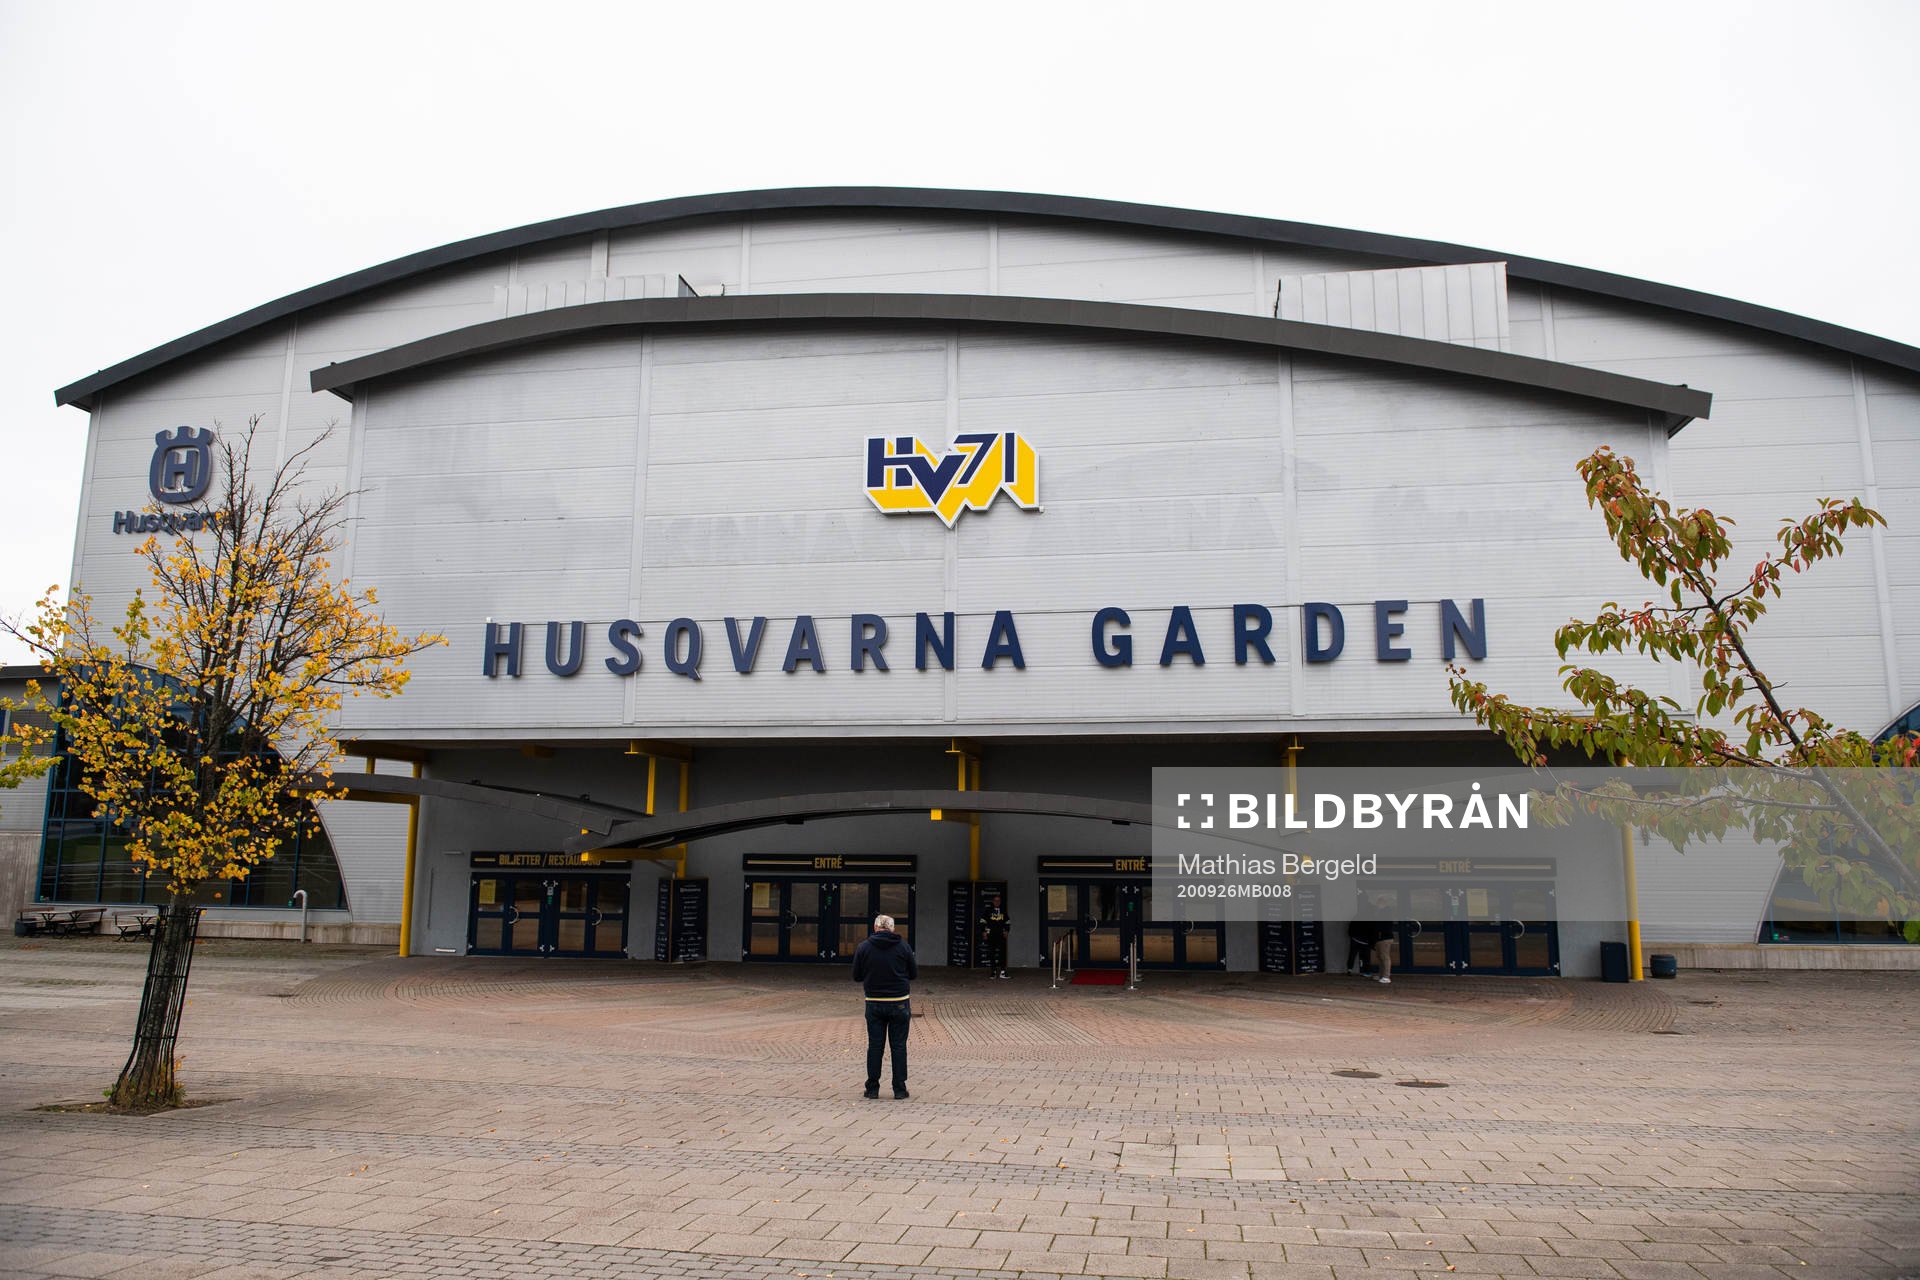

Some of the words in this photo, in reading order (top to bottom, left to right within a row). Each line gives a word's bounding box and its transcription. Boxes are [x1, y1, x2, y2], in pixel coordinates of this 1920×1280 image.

[866, 431, 1019, 506] HV71
[112, 510, 239, 536] Husqvar
[483, 610, 1026, 681] HUSQVARNA
[1091, 598, 1488, 667] GARDEN
[498, 854, 541, 866] BILJETTER
[548, 854, 601, 866] RESTAU
[814, 855, 843, 869] ENTRÉ
[1115, 856, 1146, 871] ENTRÉ
[1438, 858, 1472, 873] ENTRÉ
